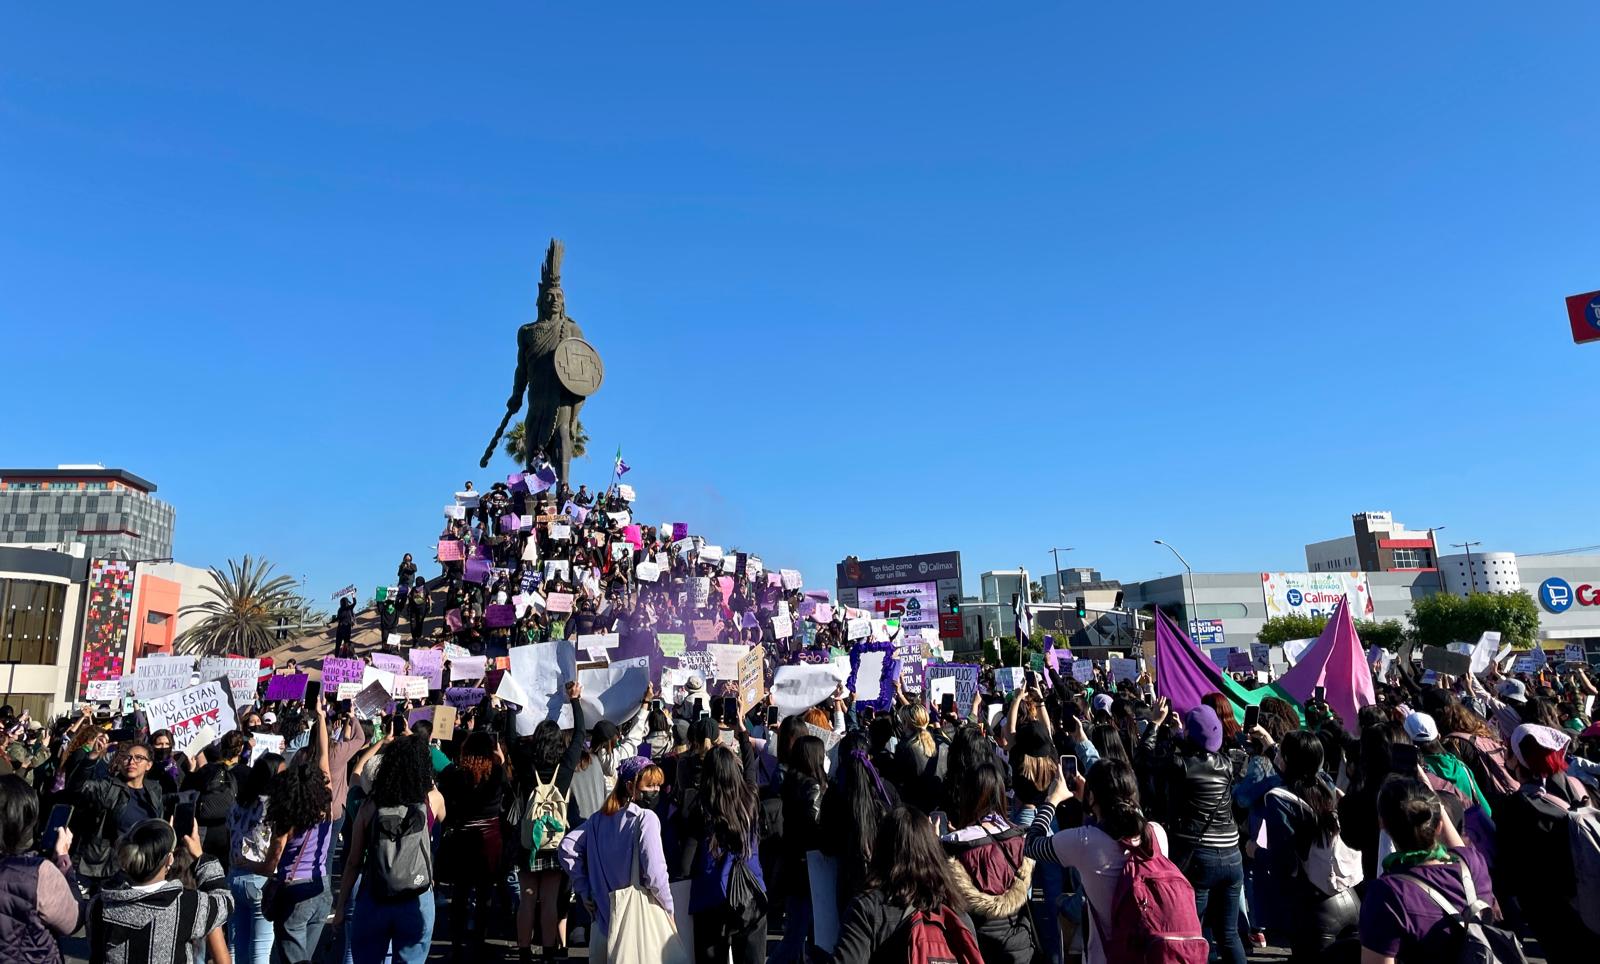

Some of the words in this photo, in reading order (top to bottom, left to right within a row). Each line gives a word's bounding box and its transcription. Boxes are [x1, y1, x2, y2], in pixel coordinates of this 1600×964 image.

[928, 562, 954, 572] Calimax
[875, 598, 906, 618] 45
[1191, 625, 1222, 634] EQUIPO
[352, 662, 362, 670] EL
[324, 675, 340, 683] QUE
[182, 685, 217, 706] ESTAN
[166, 699, 219, 726] MATANDO
[172, 726, 192, 738] ADIE
